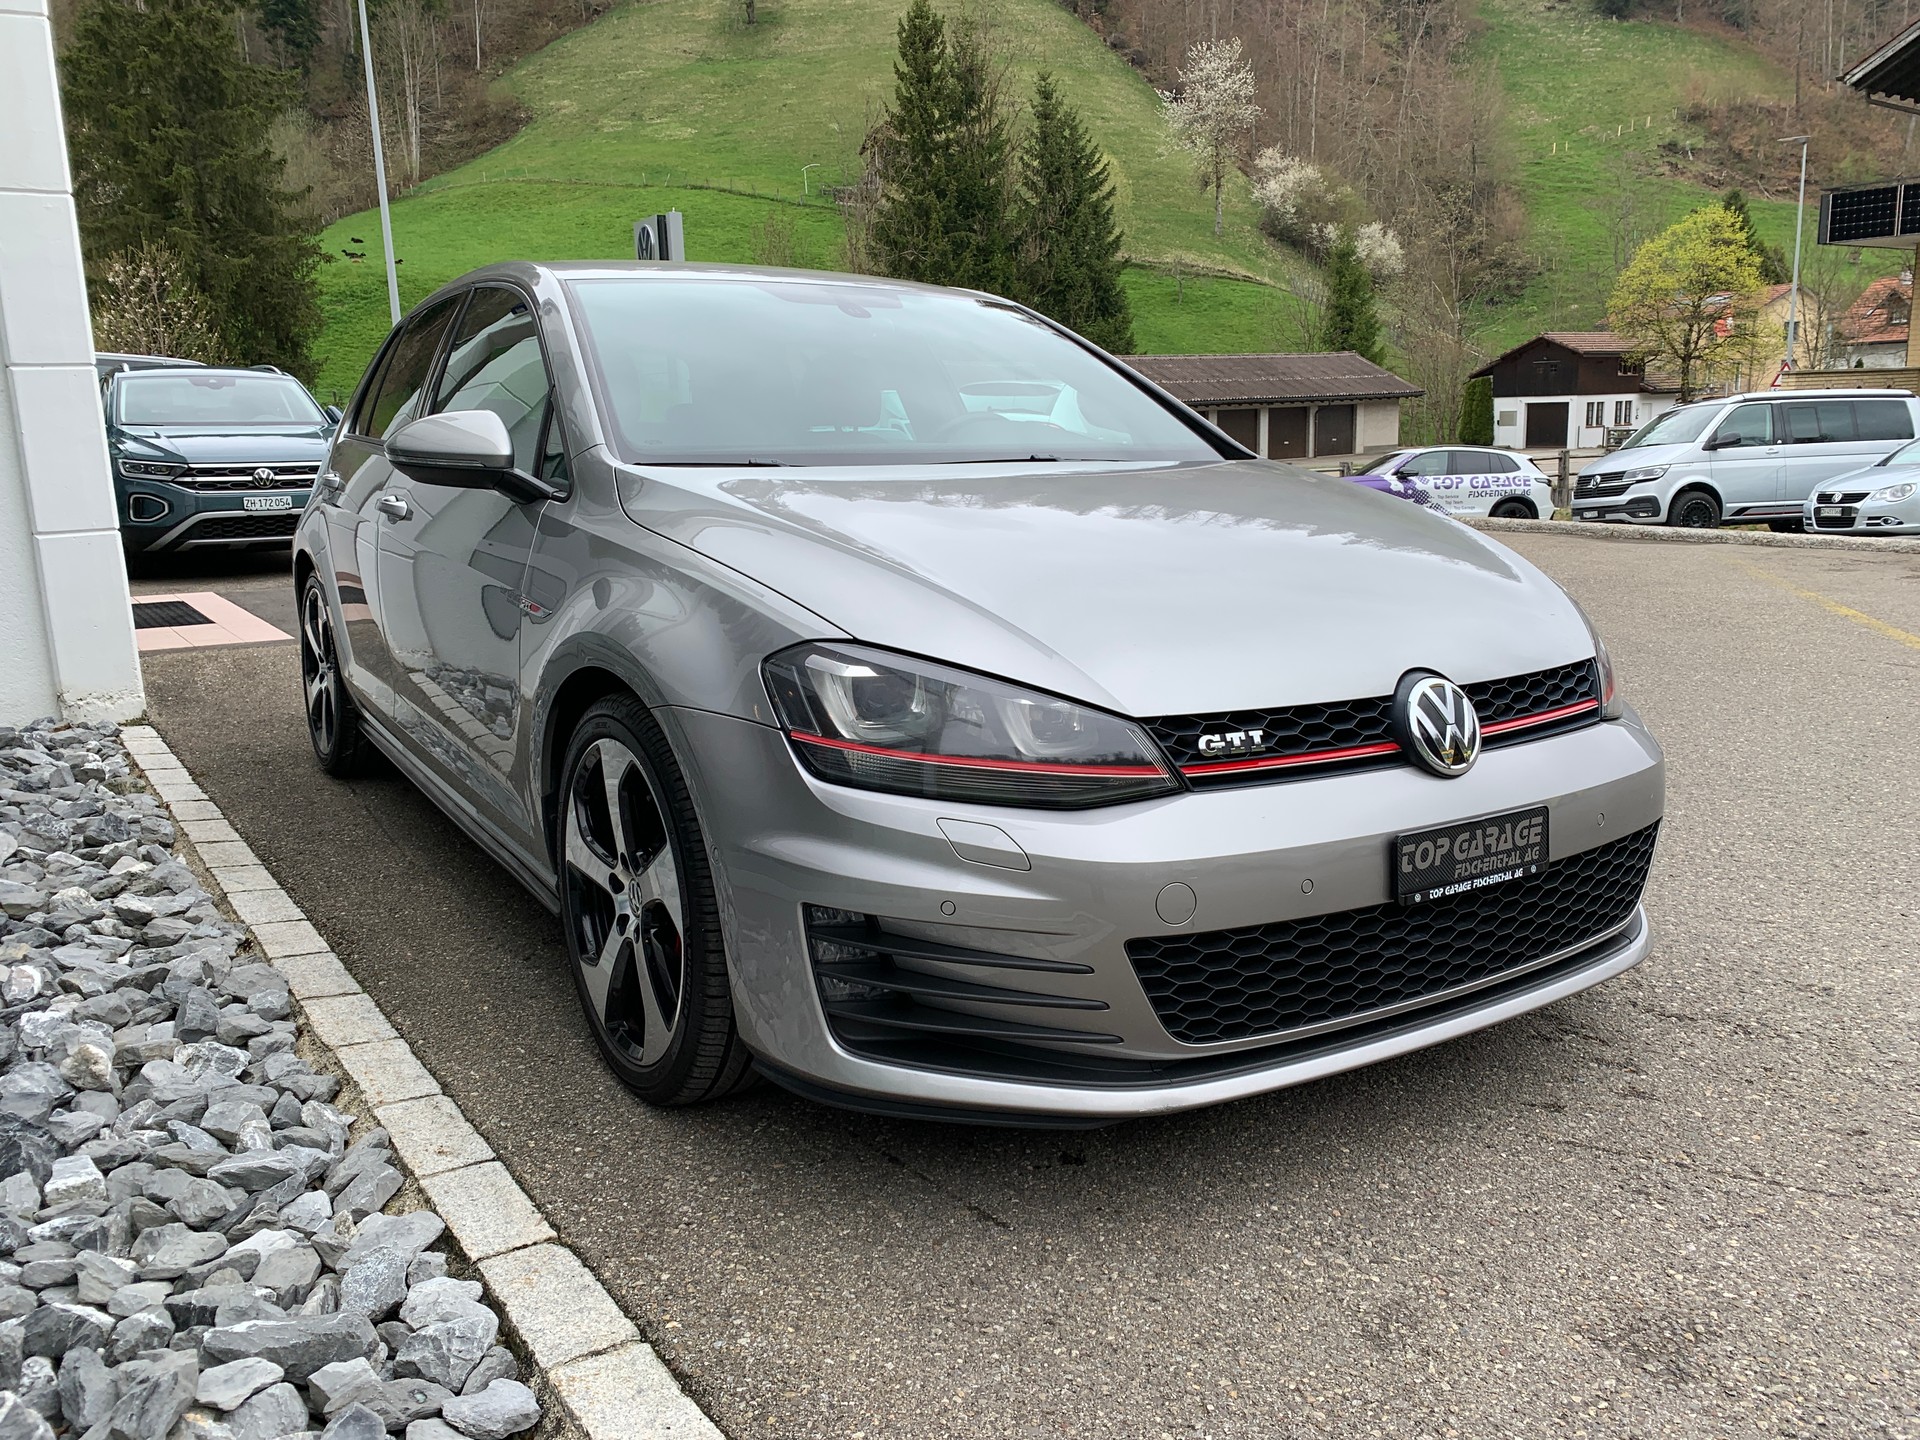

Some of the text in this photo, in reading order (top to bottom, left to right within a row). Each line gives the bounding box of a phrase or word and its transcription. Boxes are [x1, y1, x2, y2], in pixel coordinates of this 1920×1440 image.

[1434, 476, 1531, 490] TOP GARAGE
[1198, 729, 1266, 757] GTI
[1401, 816, 1543, 873] TOP GARAGE
[1454, 846, 1540, 879] FISCHENTHAL AG
[1429, 868, 1524, 899] TOP GARAGE FISCHENTHAL AG
